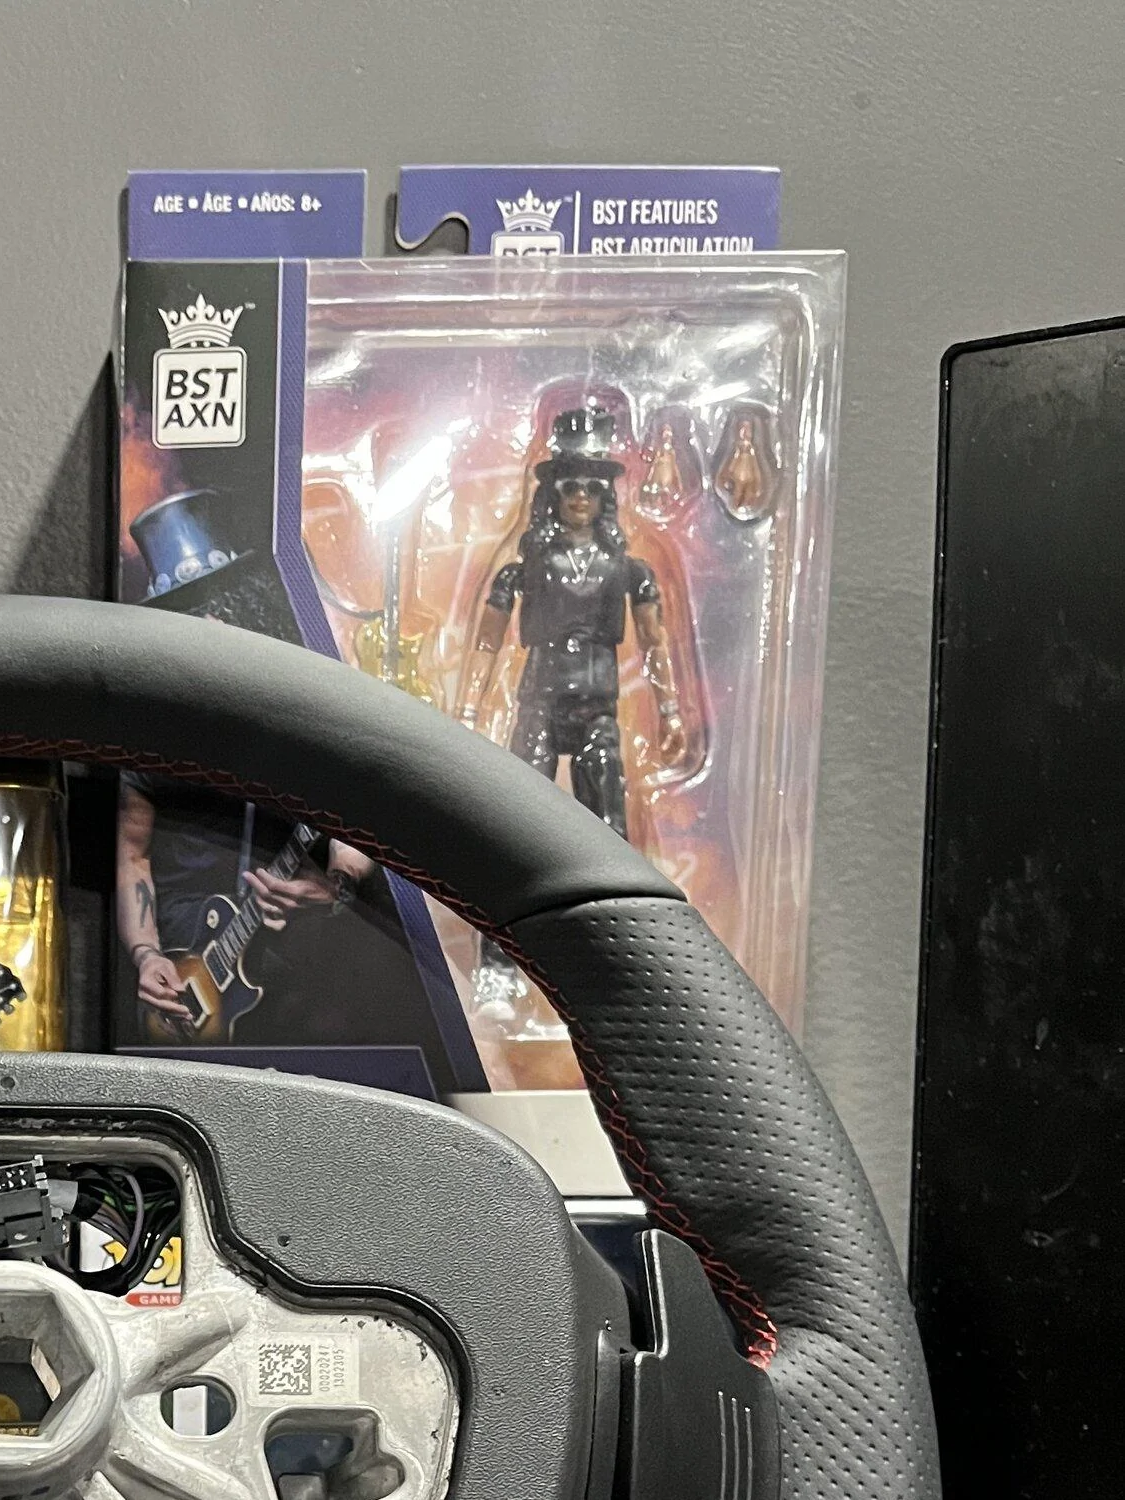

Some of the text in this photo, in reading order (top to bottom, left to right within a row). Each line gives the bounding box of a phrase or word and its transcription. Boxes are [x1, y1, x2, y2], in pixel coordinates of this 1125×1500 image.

[153, 195, 184, 213] AGE
[301, 194, 322, 212] 8+
[592, 199, 718, 225] BST FEATURES
[591, 236, 754, 256] BST ARTICULATION
[165, 367, 238, 400] BST
[163, 402, 237, 429] AXN
